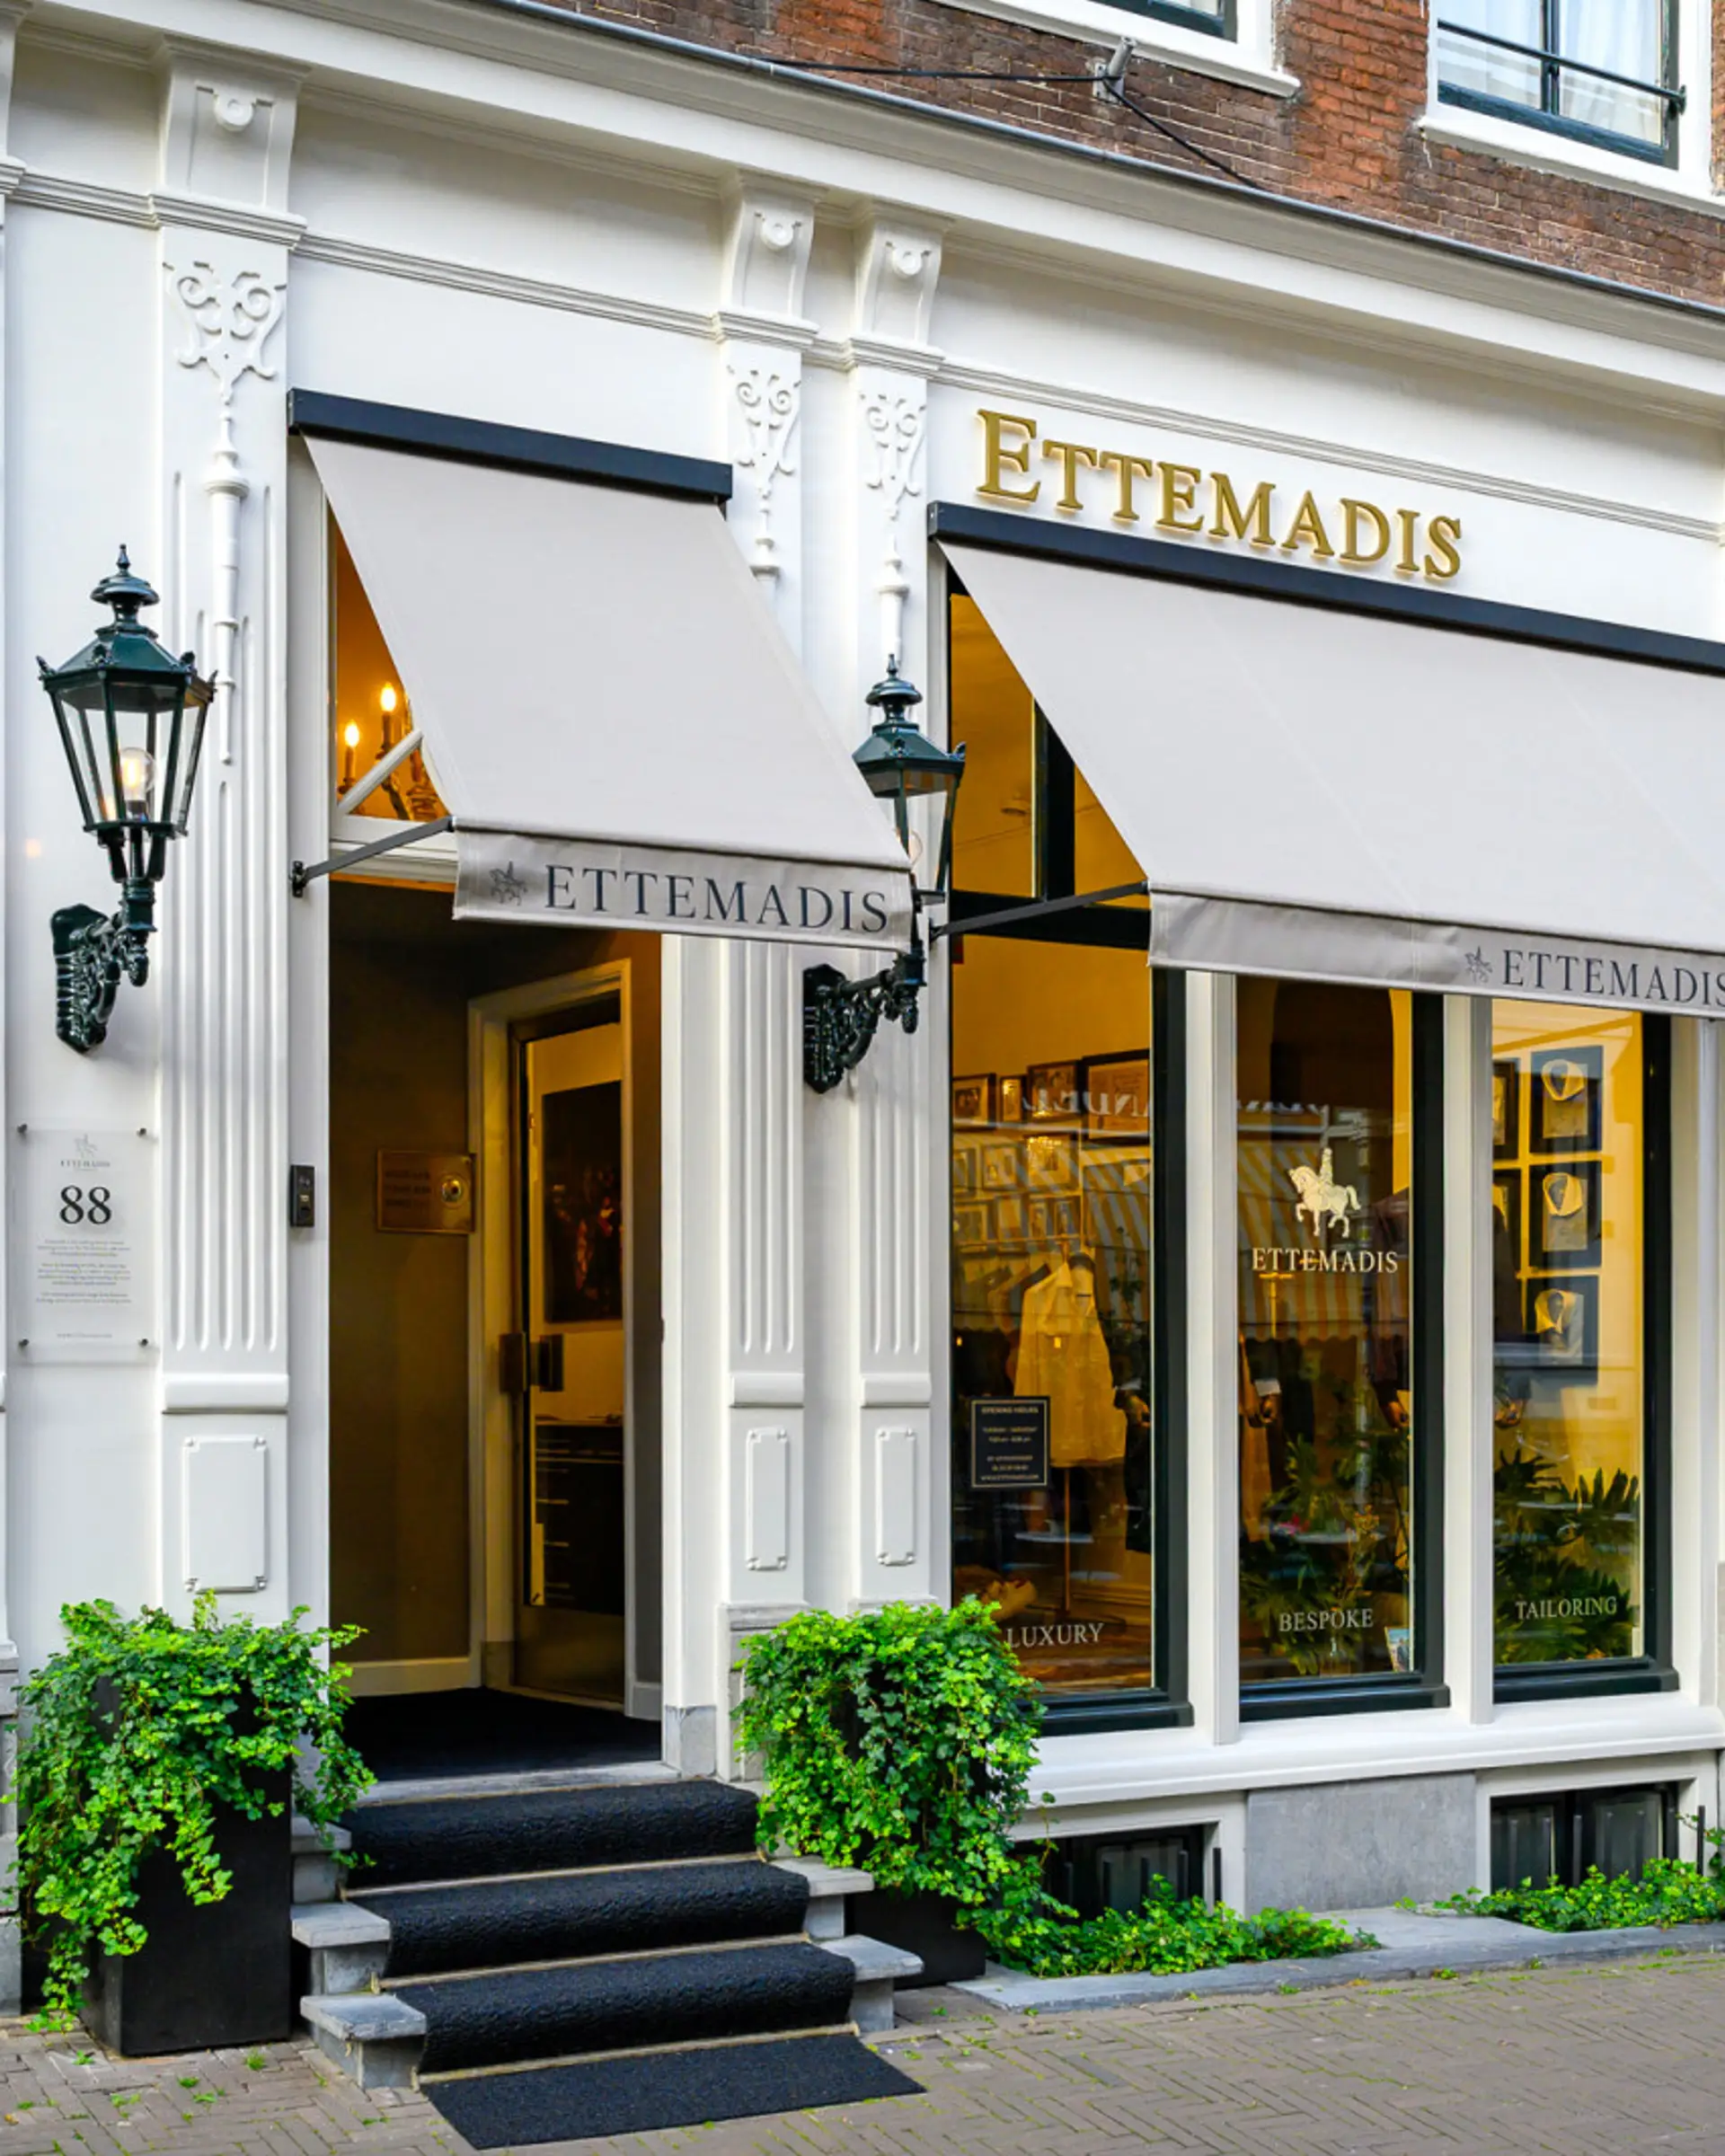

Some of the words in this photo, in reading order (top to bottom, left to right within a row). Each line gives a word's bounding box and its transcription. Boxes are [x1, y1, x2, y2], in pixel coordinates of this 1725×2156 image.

[976, 408, 1462, 579] ETTEMADIS
[545, 864, 888, 932] ETTEMADIS
[59, 1185, 111, 1224] 88
[1252, 1248, 1398, 1273] ETTEMADIS
[1278, 1608, 1374, 1632] BESPOKE
[1516, 1596, 1617, 1620] TAILORING
[1006, 1622, 1104, 1648] LUXURY
